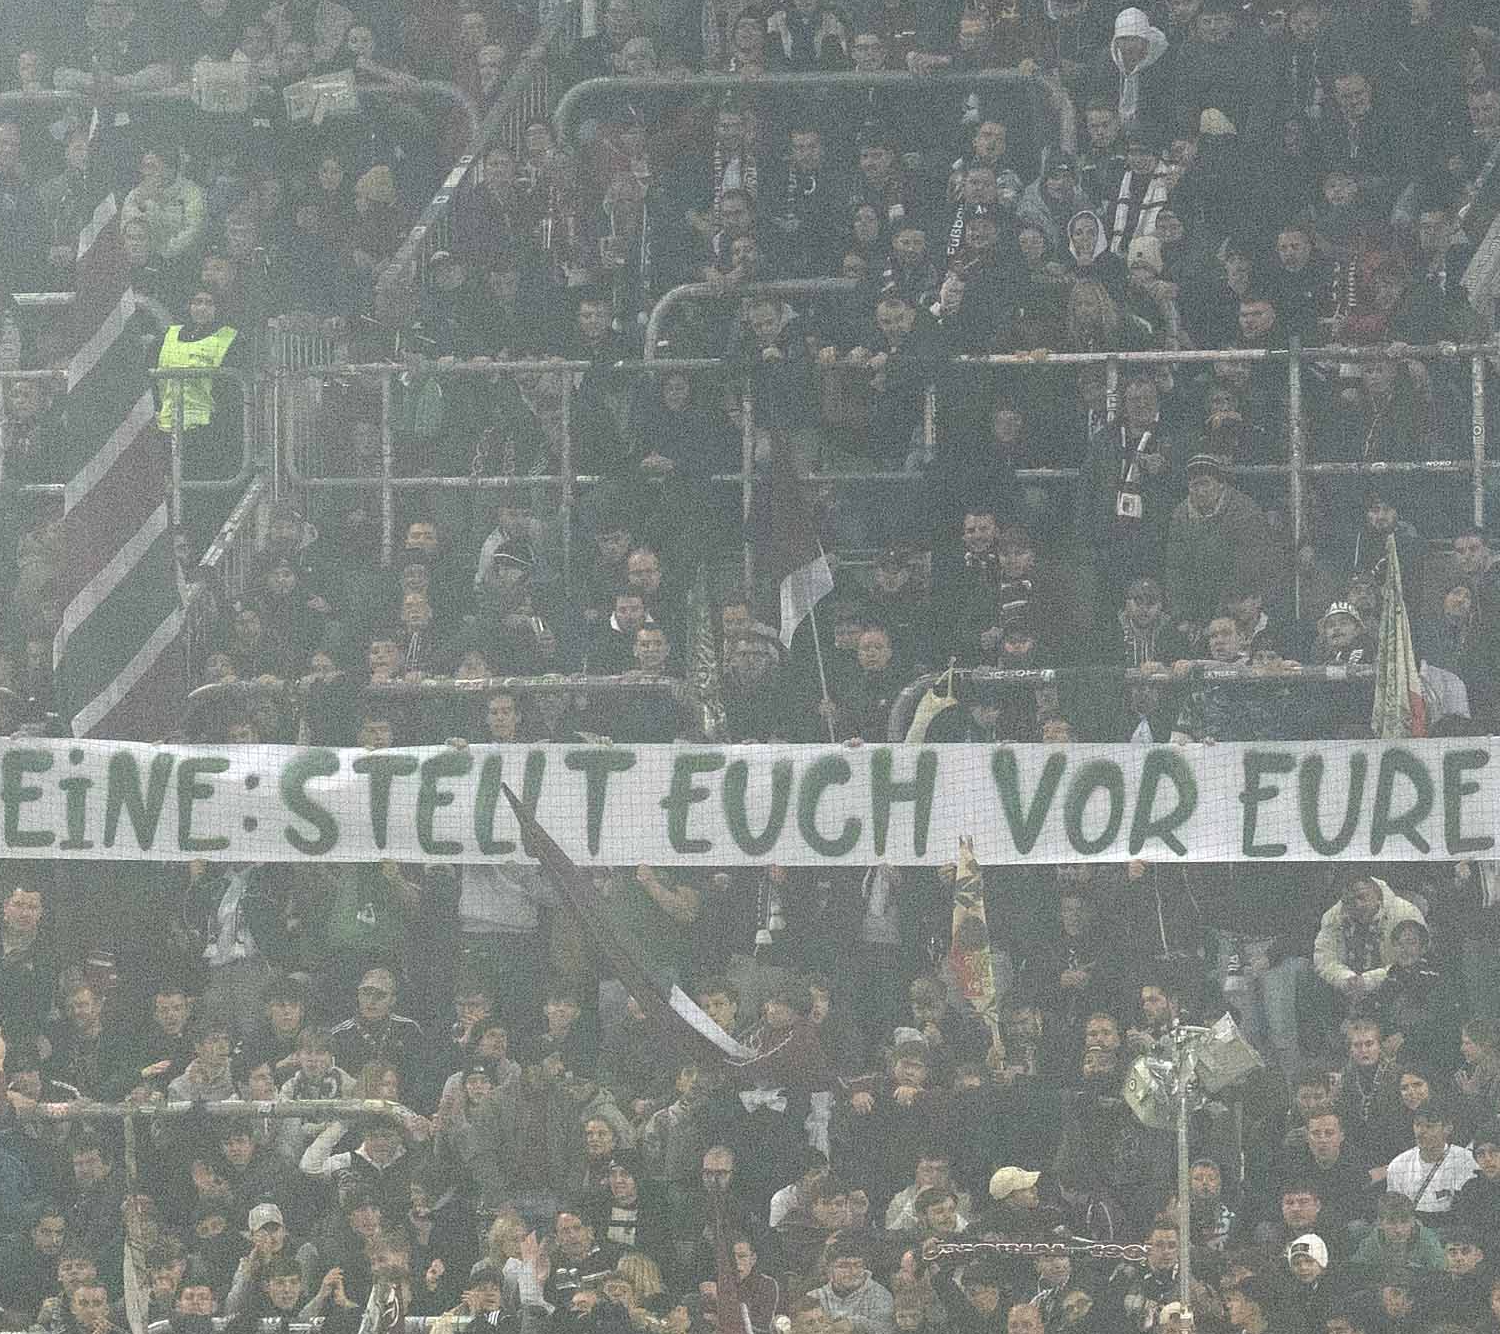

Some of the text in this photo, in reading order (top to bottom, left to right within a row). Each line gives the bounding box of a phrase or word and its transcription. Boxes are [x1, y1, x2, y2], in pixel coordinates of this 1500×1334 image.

[660, 748, 938, 857] EUCH
[990, 747, 1198, 857] VOR
[1240, 747, 1496, 857] EURE
